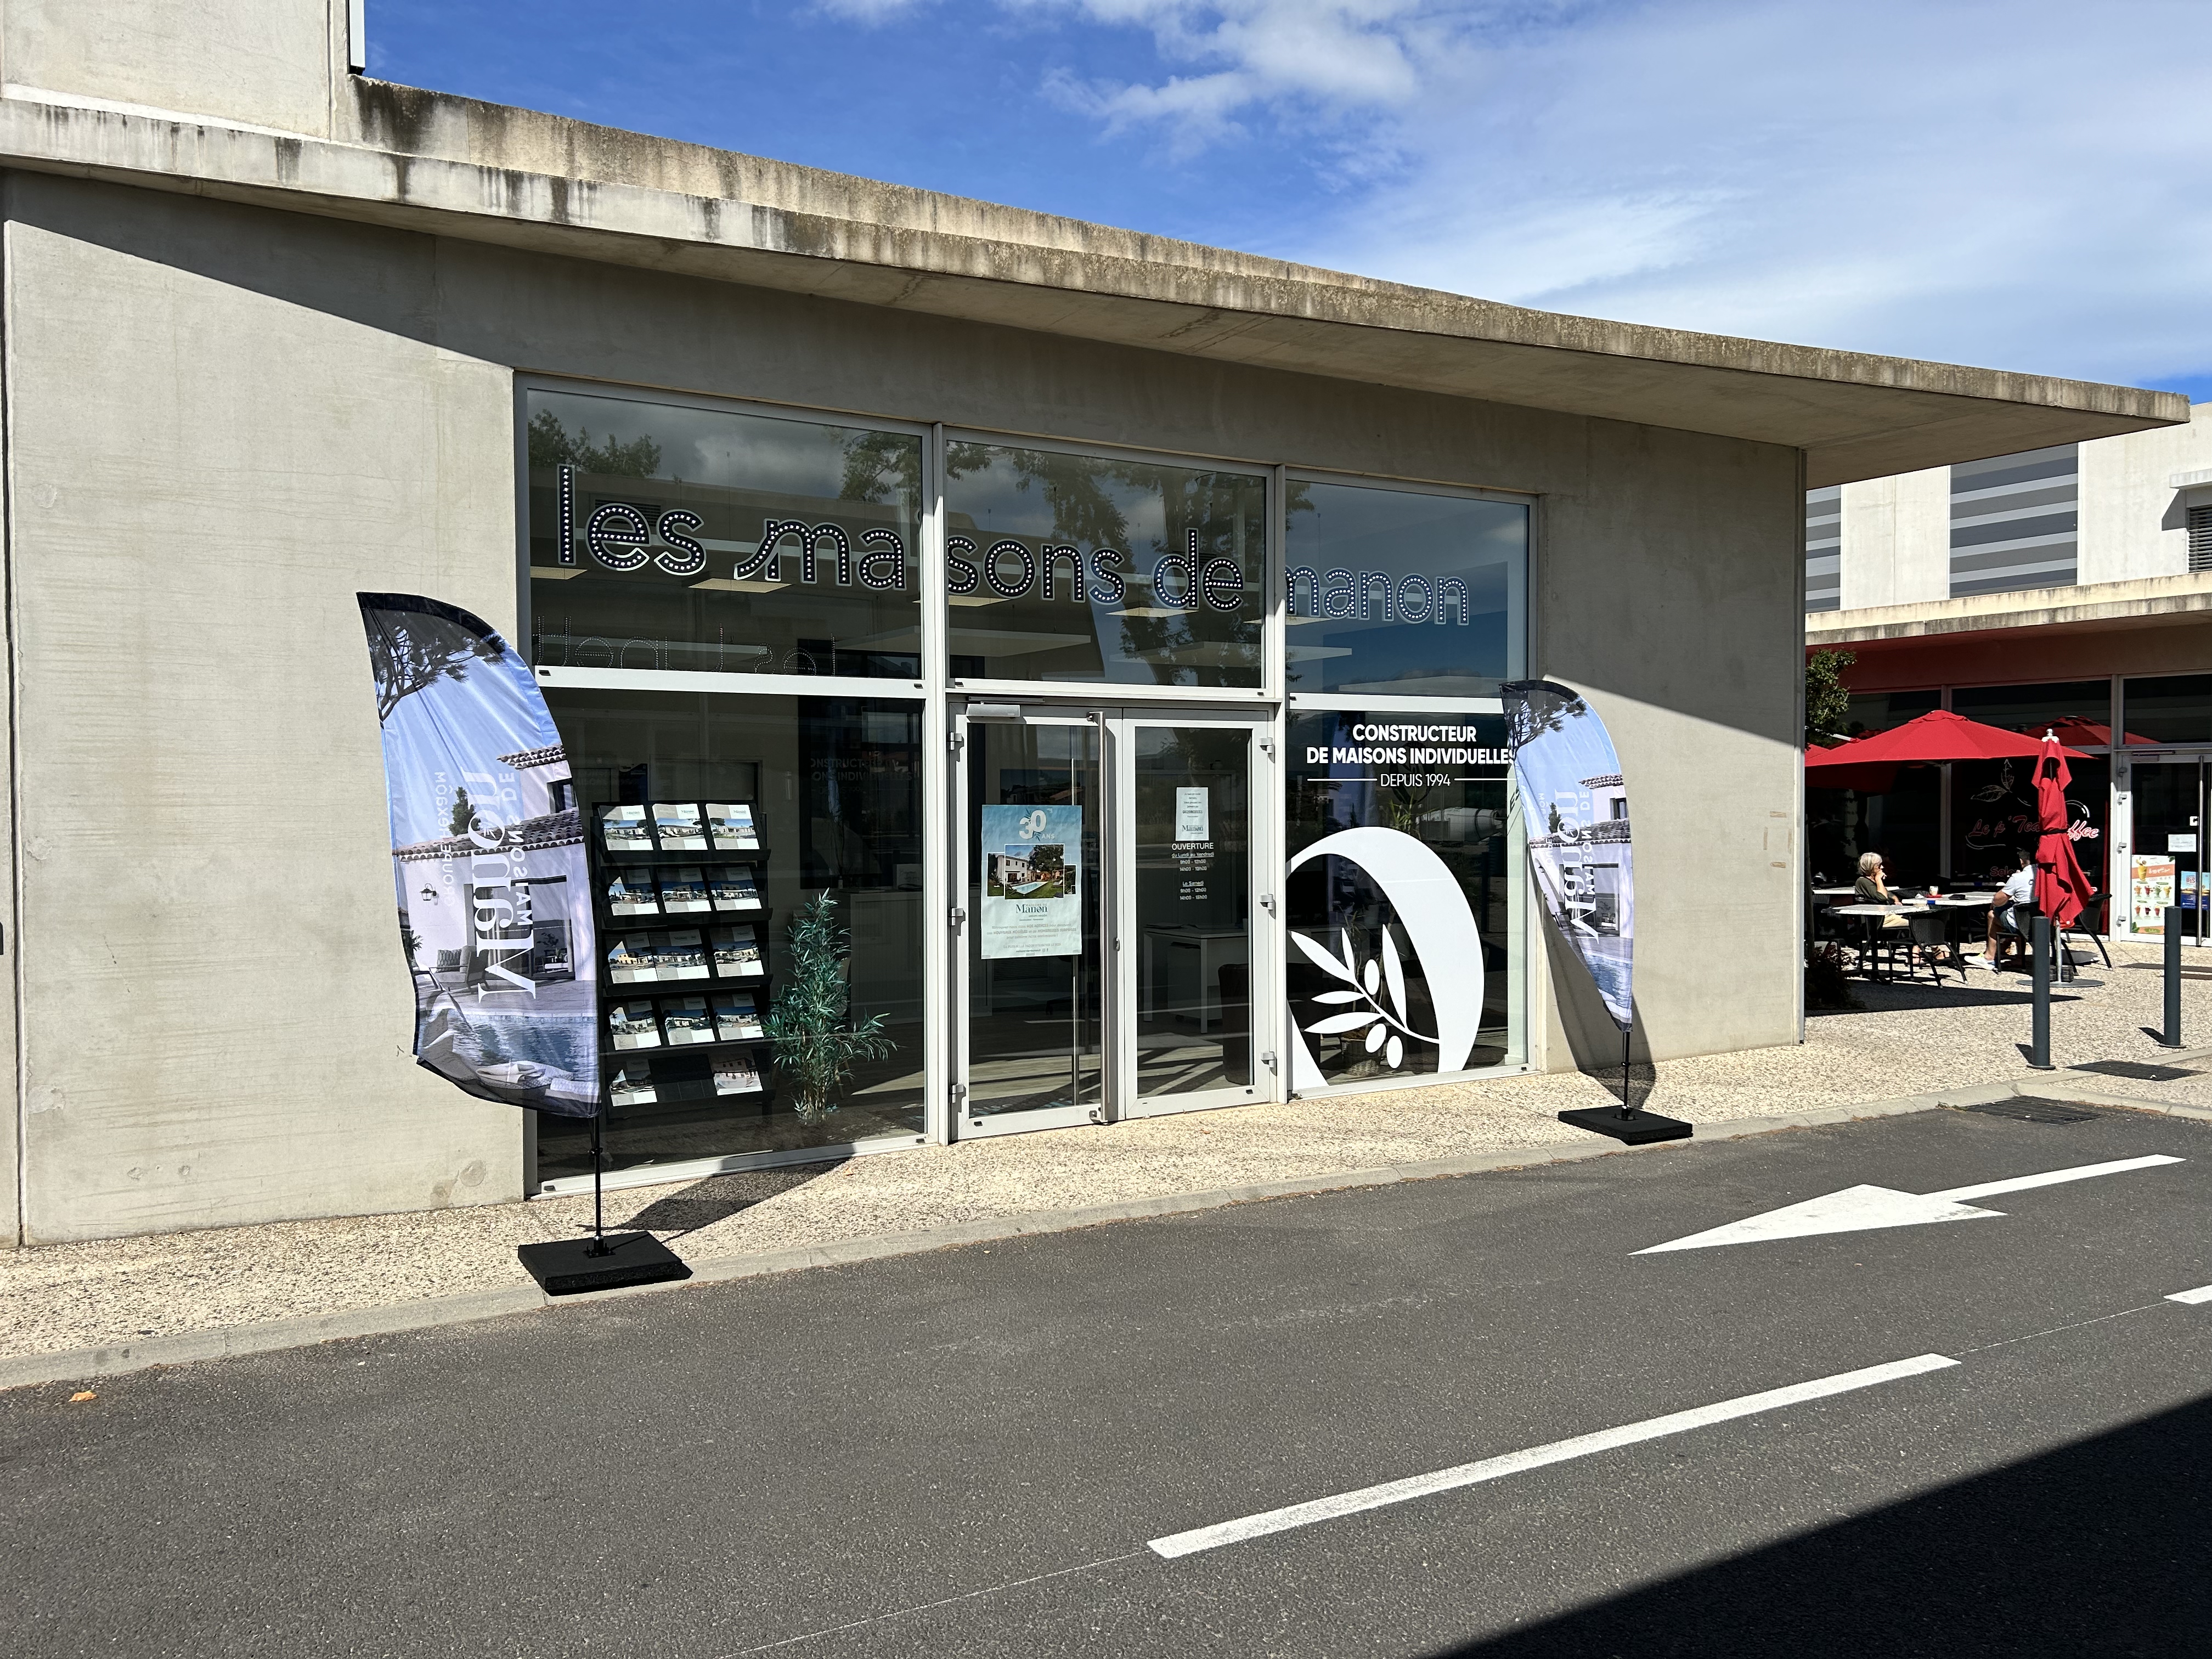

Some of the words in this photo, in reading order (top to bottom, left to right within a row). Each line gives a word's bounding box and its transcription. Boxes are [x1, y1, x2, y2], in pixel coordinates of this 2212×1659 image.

[557, 464, 707, 575] les
[733, 518, 1126, 605] masons
[1152, 528, 1244, 612] de
[1353, 724, 1476, 742] CONSTRUCTEUR
[1306, 747, 1328, 764] DE
[1333, 747, 1406, 765] MAISONS
[1380, 774, 1423, 787] DEPUIS
[1426, 774, 1451, 787] 1994
[1019, 809, 1047, 839] 30
[1968, 819, 1990, 837] Le
[1171, 842, 1214, 850] OUVERTURE
[1016, 904, 1047, 913] Manon
